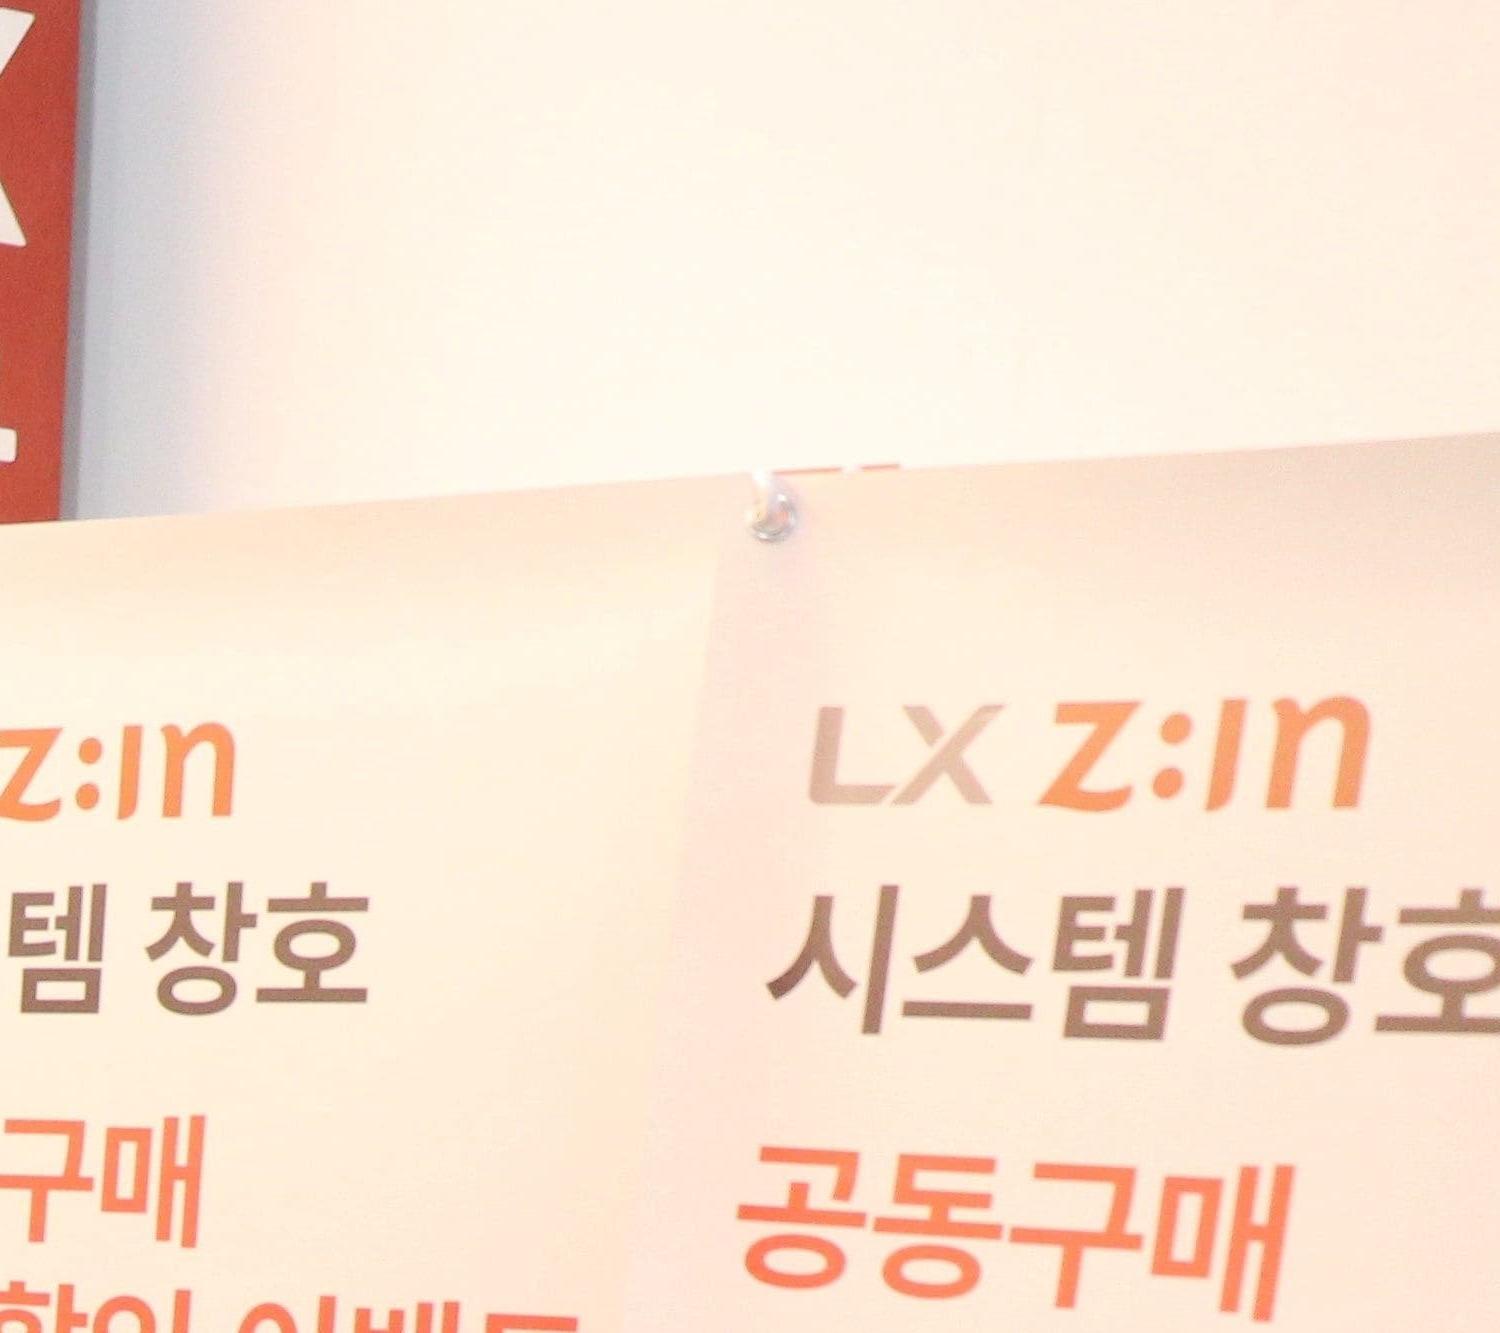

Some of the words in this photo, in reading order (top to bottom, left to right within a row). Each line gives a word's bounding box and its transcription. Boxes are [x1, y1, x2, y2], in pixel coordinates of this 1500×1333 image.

[808, 704, 1006, 806] LX
[145, 880, 370, 1016] 창호
[766, 885, 1186, 1040] 시스템
[1229, 887, 1500, 1047] 창호
[735, 1145, 1297, 1323] 공동구매
